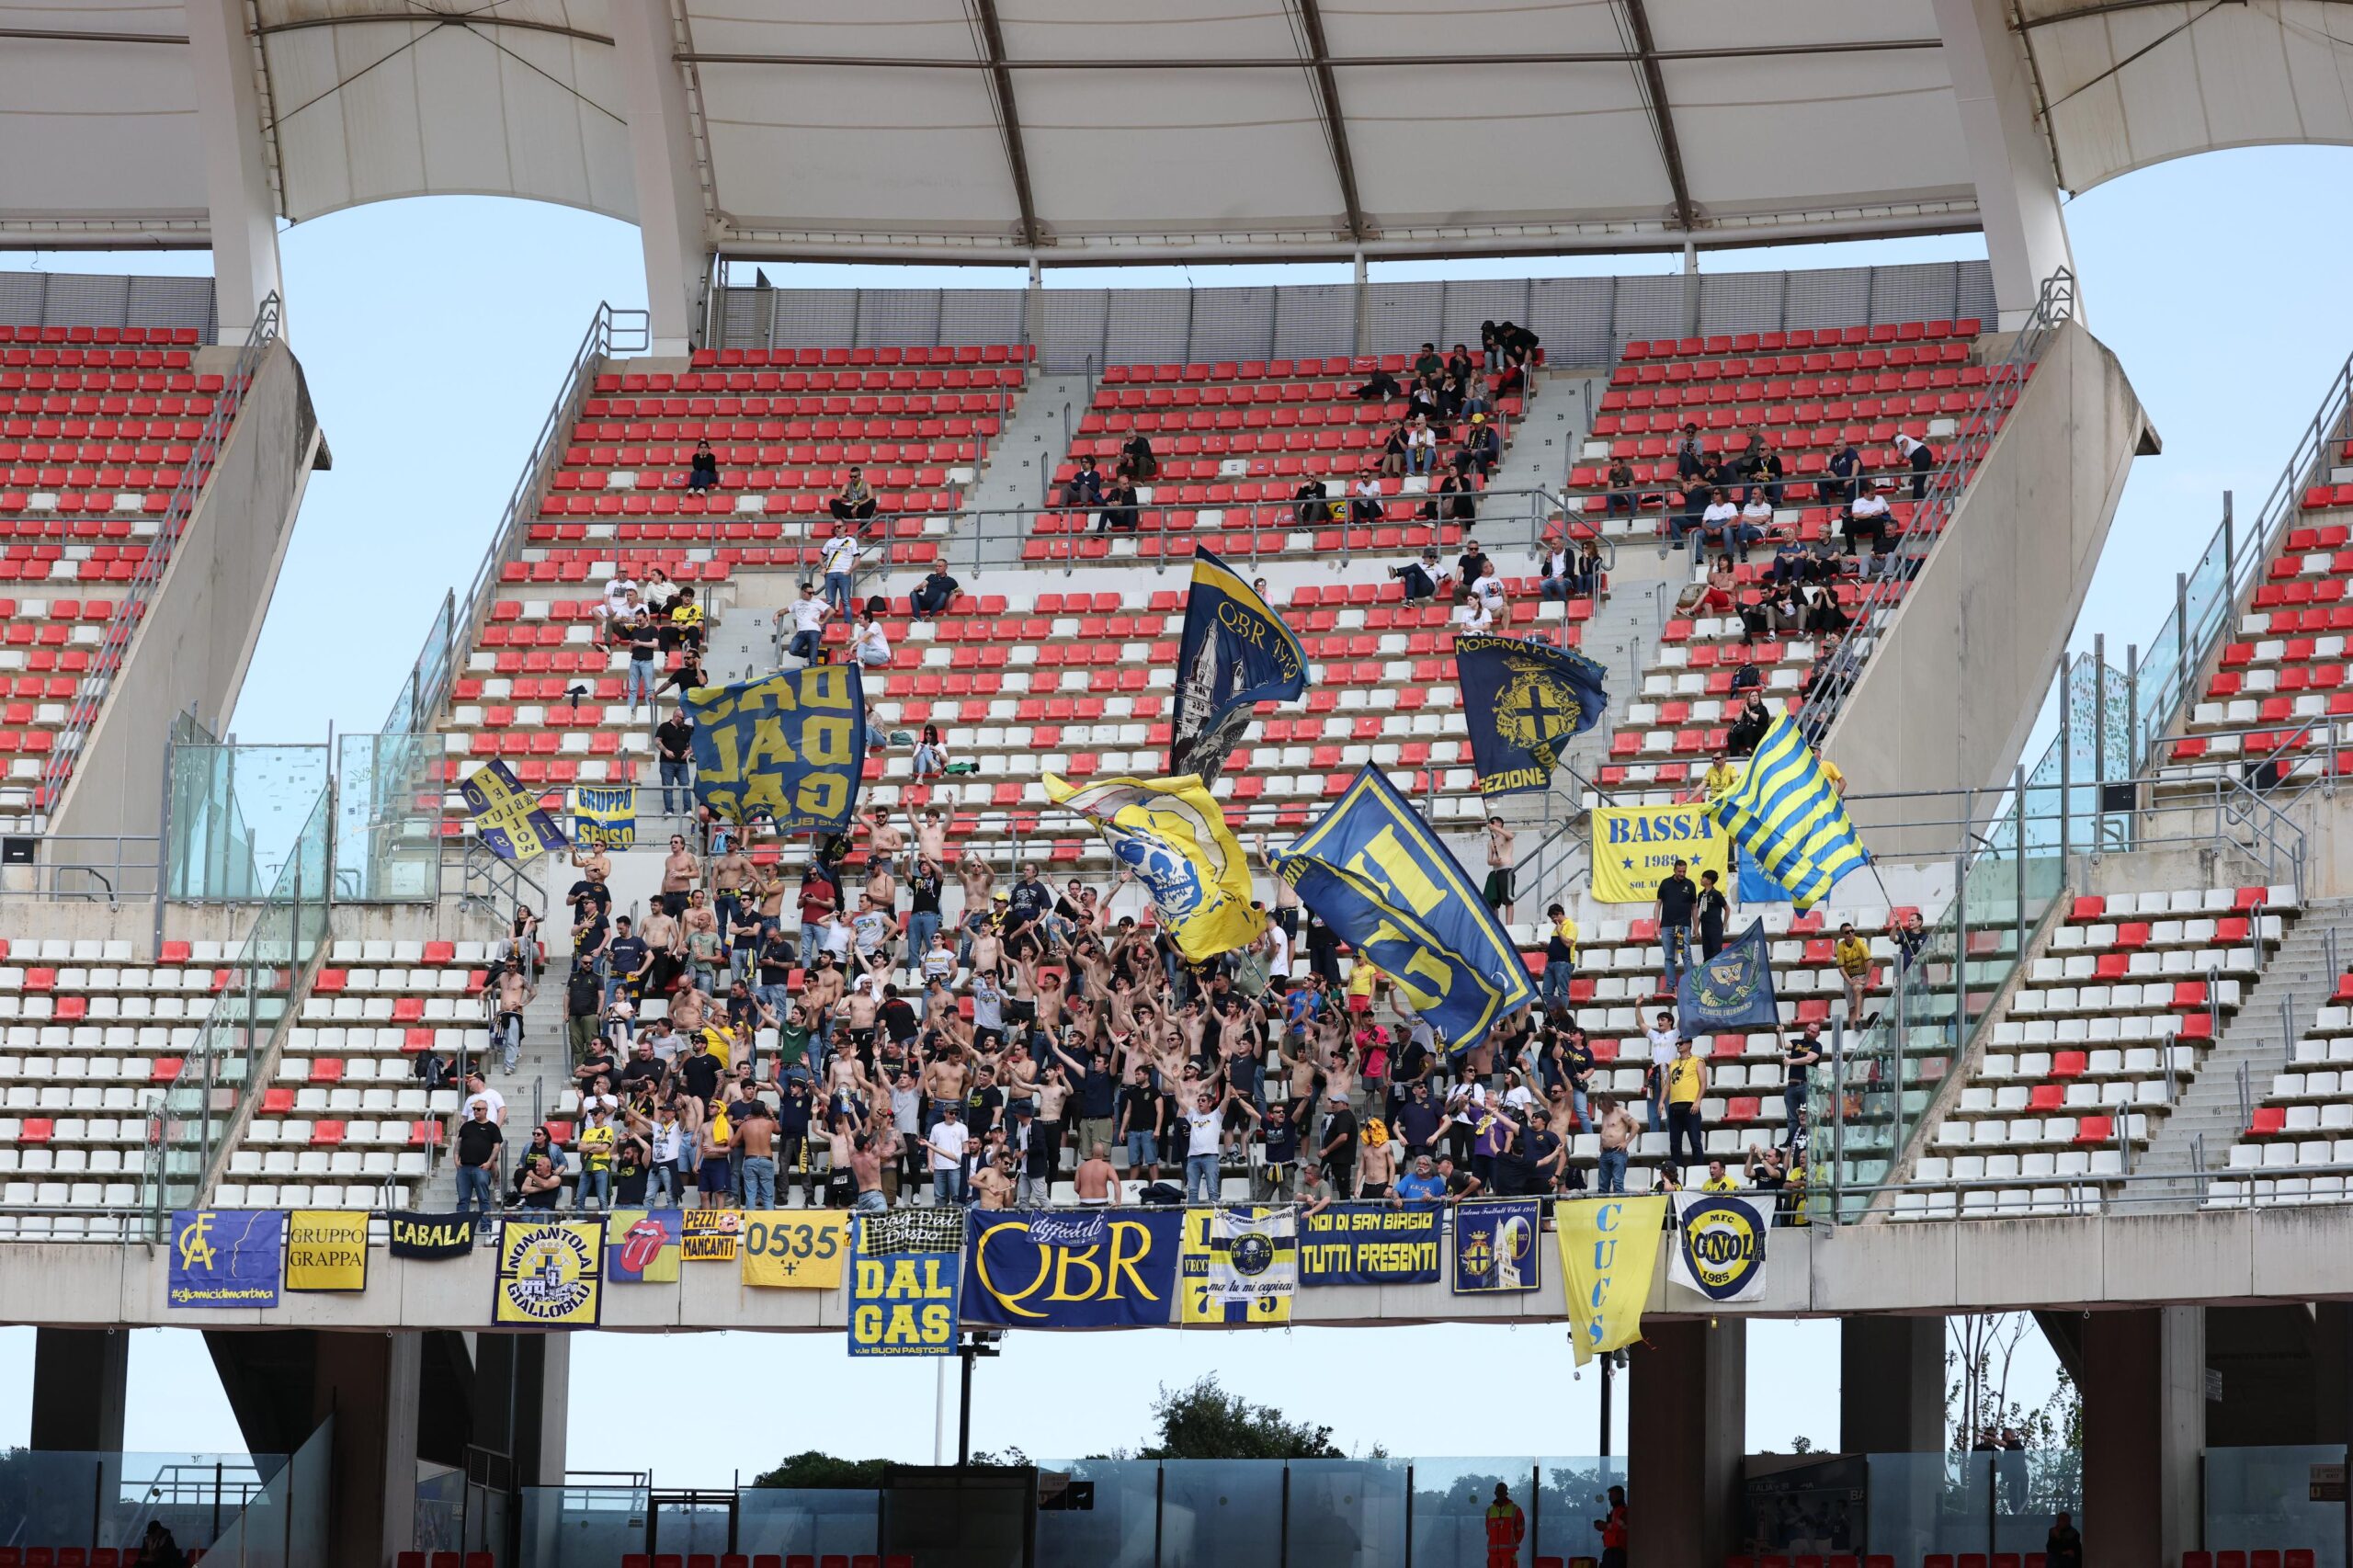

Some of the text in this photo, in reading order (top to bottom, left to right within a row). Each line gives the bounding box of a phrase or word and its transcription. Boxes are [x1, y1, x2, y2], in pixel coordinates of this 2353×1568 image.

[754, 619, 762, 627] 22
[1218, 601, 1266, 650] QBR
[1630, 618, 1638, 626] 21
[741, 645, 749, 653] 21
[1616, 645, 1623, 653] 20
[728, 671, 736, 679] 20
[578, 786, 632, 812] GRUPPO
[1608, 814, 1714, 844] BASSA
[1643, 854, 1680, 869] 1989
[2299, 972, 2308, 982] 09
[550, 1026, 558, 1034] 09
[2256, 1039, 2265, 1048] 07
[517, 1086, 526, 1095] 07
[1354, 1107, 1362, 1115] 06
[2212, 1107, 2222, 1116] 05
[2167, 1177, 2177, 1187] 03
[1481, 1206, 1506, 1215] Football
[1522, 1205, 1538, 1213] 1912
[686, 1210, 717, 1228] PEZZI
[873, 1211, 957, 1231] Dag Dal
[1308, 1214, 1332, 1231] NOI
[1336, 1215, 1349, 1231] DI
[1352, 1213, 1380, 1230] SAN
[1383, 1212, 1434, 1230] BIAGIO
[1710, 1214, 1734, 1223] MFC
[290, 1228, 364, 1244] GRUPPO
[393, 1220, 470, 1247] CABALA
[746, 1221, 838, 1260] 0535
[1678, 1220, 1767, 1262] VGNOLA
[508, 1226, 593, 1270] NONANTOLA
[683, 1238, 734, 1257] MANCANTI
[1259, 1250, 1270, 1258] 75
[290, 1251, 362, 1267] GRAPPA
[1302, 1242, 1438, 1274] TUTTI PRESENTI
[976, 1221, 1160, 1318] QBR
[1702, 1270, 1730, 1283] 1985
[855, 1259, 952, 1299] DAL
[1209, 1280, 1294, 1295] ma tu mi capirai
[171, 1288, 274, 1303] #gliamicidimartina
[506, 1283, 591, 1318] GIALLOBLU
[854, 1304, 951, 1345] GAS
